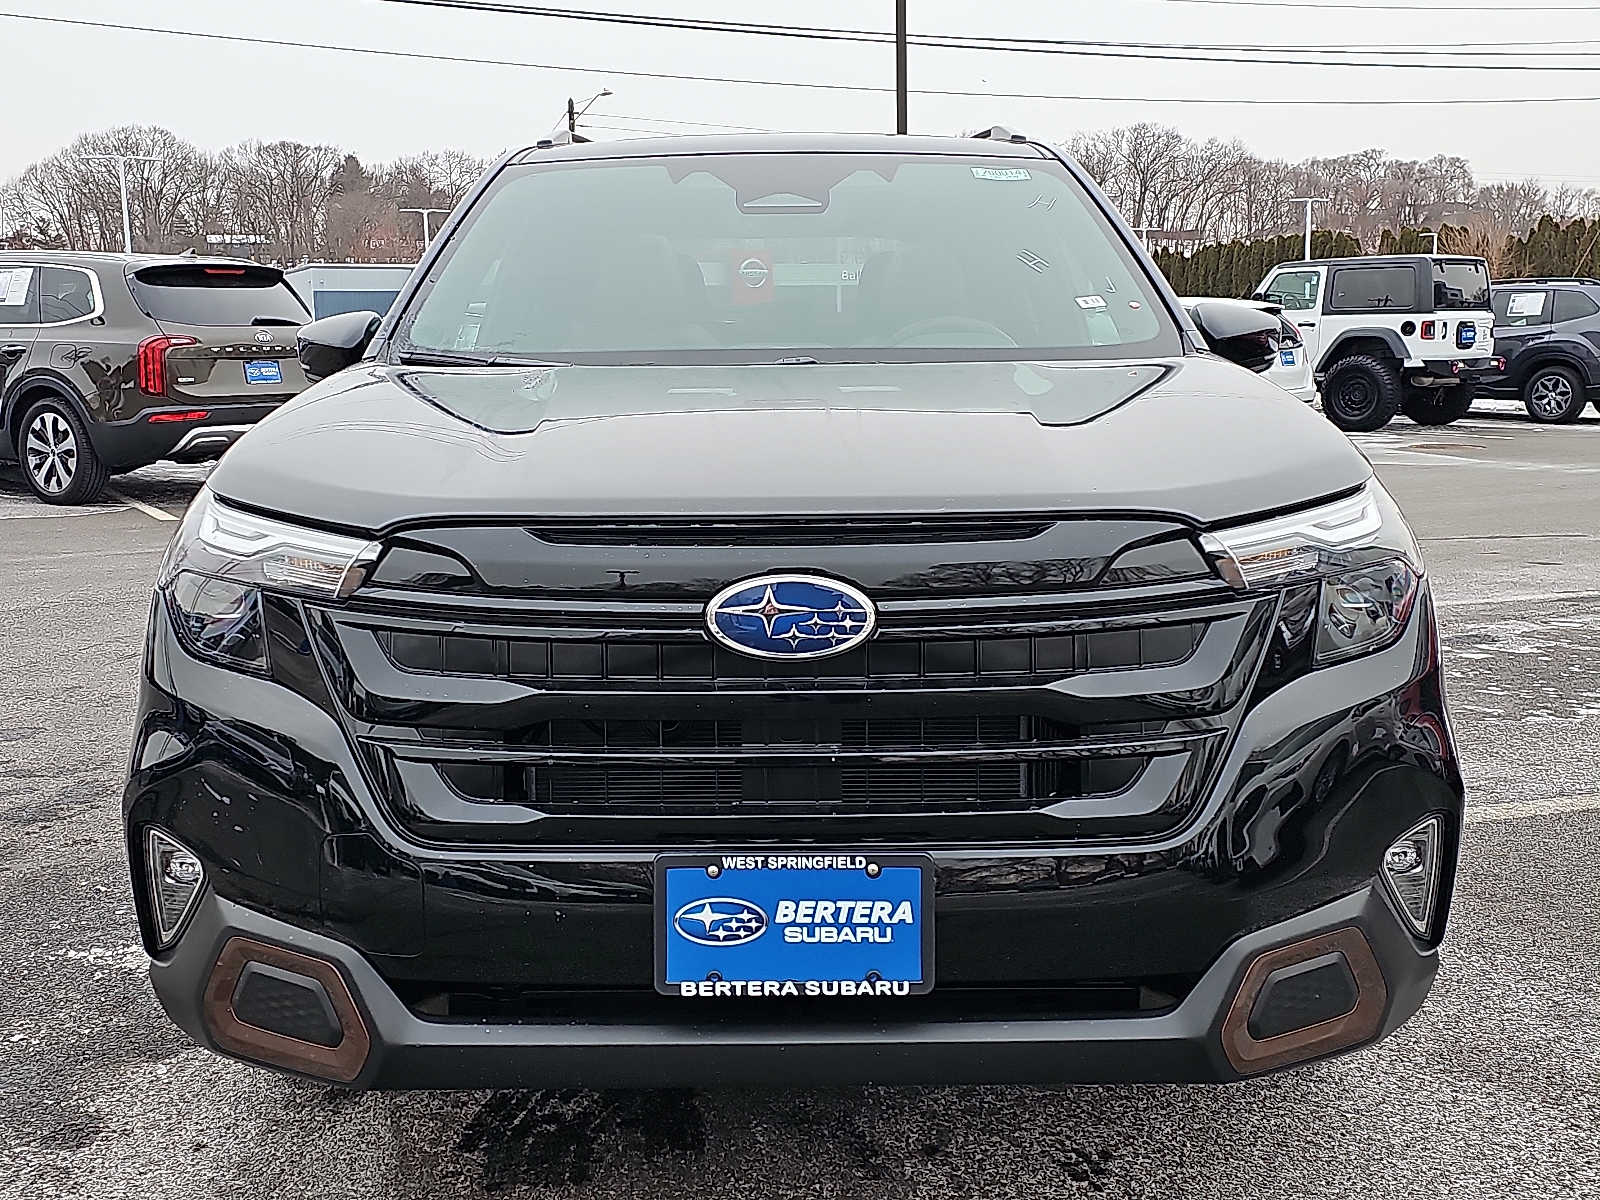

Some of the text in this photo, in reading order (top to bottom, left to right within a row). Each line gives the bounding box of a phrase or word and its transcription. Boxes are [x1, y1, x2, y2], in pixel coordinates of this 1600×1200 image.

[722, 856, 867, 869] WEST SPRINGFIELD
[774, 900, 914, 924] BERTERA
[783, 926, 893, 943] SUBARU
[680, 980, 910, 996] BERTERA SUBARU
